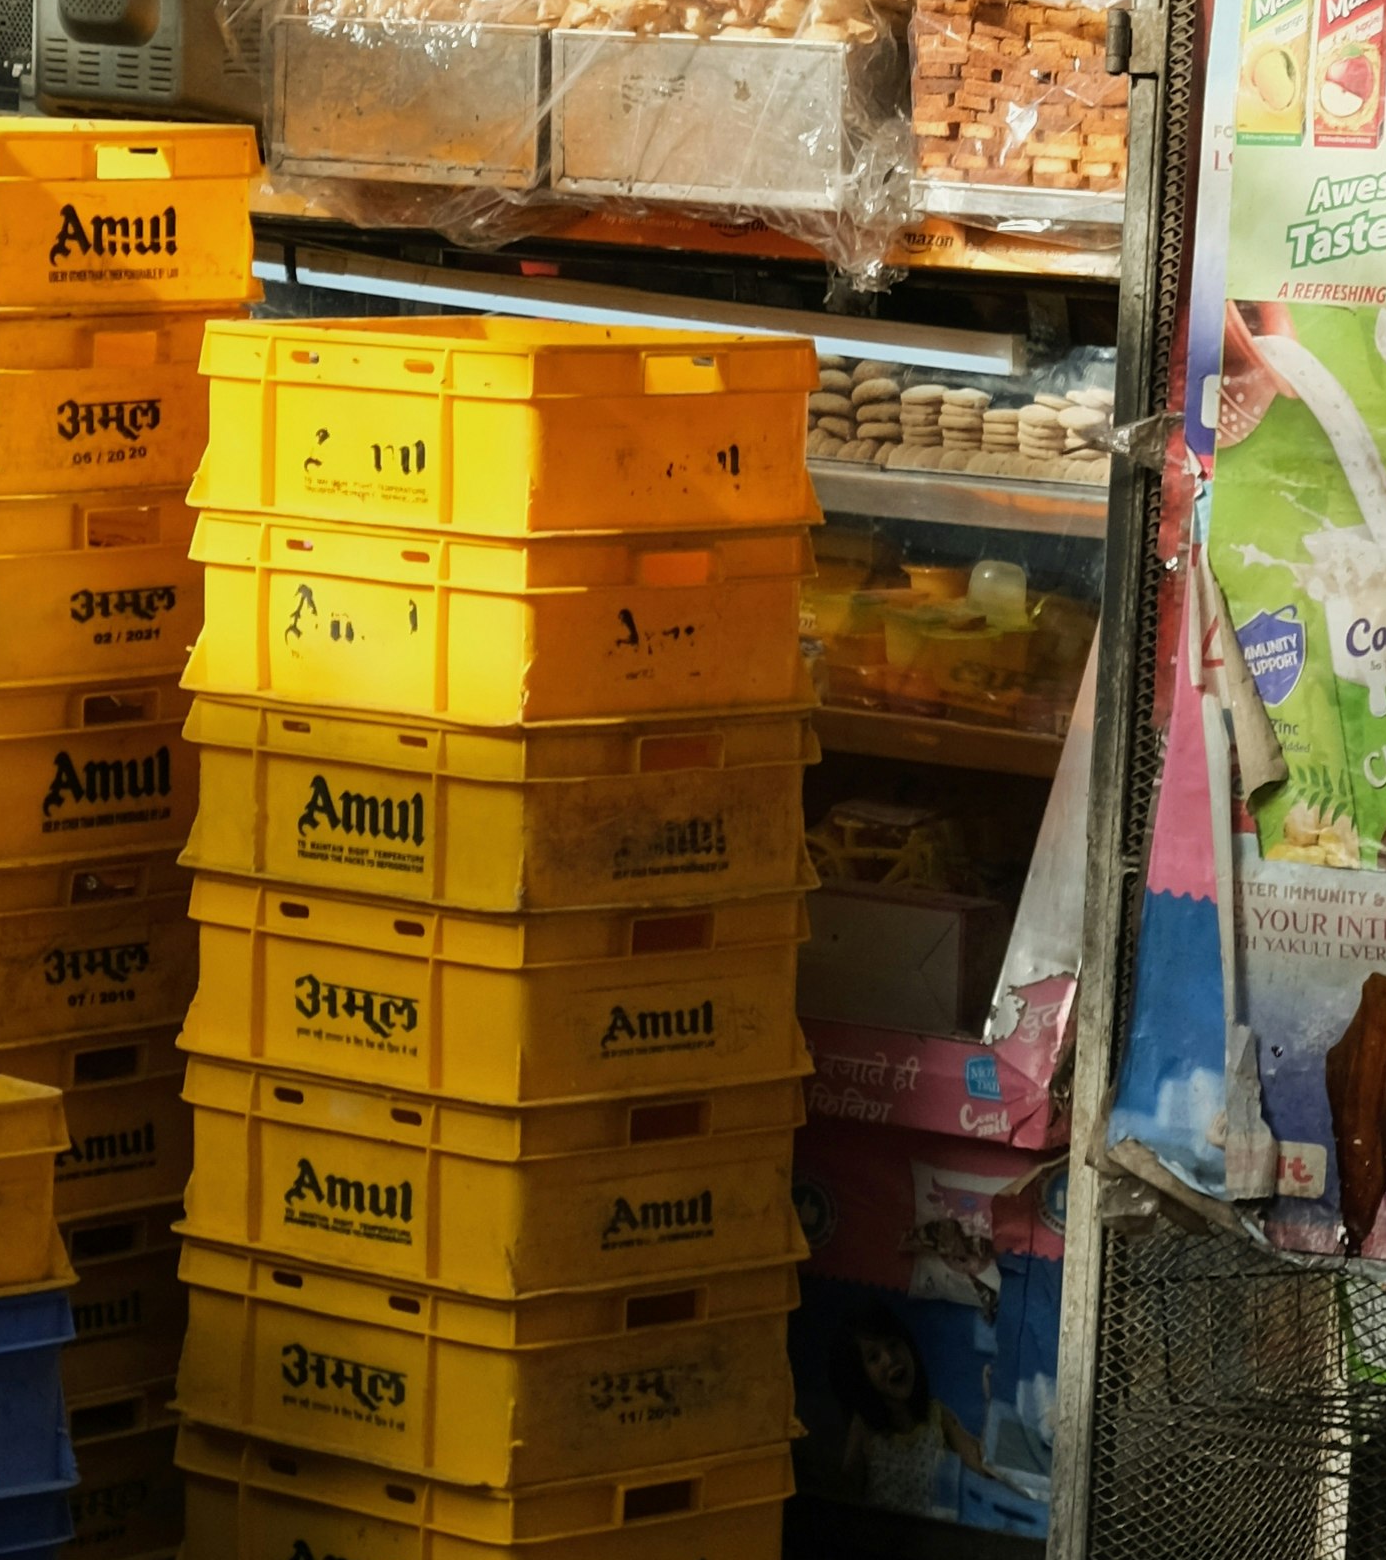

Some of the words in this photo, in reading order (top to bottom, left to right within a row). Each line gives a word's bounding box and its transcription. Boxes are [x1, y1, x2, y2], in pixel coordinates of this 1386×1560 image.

[50, 204, 177, 266] Amul
[1278, 282, 1288, 298] A
[1293, 283, 1386, 304] REFRESHING
[57, 398, 161, 441] अमूल
[70, 585, 176, 623] अमूल
[43, 746, 171, 817] Amul
[297, 775, 424, 846] Amul
[1284, 886, 1366, 906] IMMUNITY
[1374, 893, 1384, 907] &
[1252, 907, 1327, 937] YOUR
[44, 941, 149, 984] अमूल
[1263, 937, 1331, 957] YAKULT
[295, 974, 419, 1038] अमूल
[601, 1000, 714, 1048] Amul
[284, 1158, 412, 1223] Amul
[601, 1190, 713, 1238] Amul
[281, 1344, 406, 1409] अमूल
